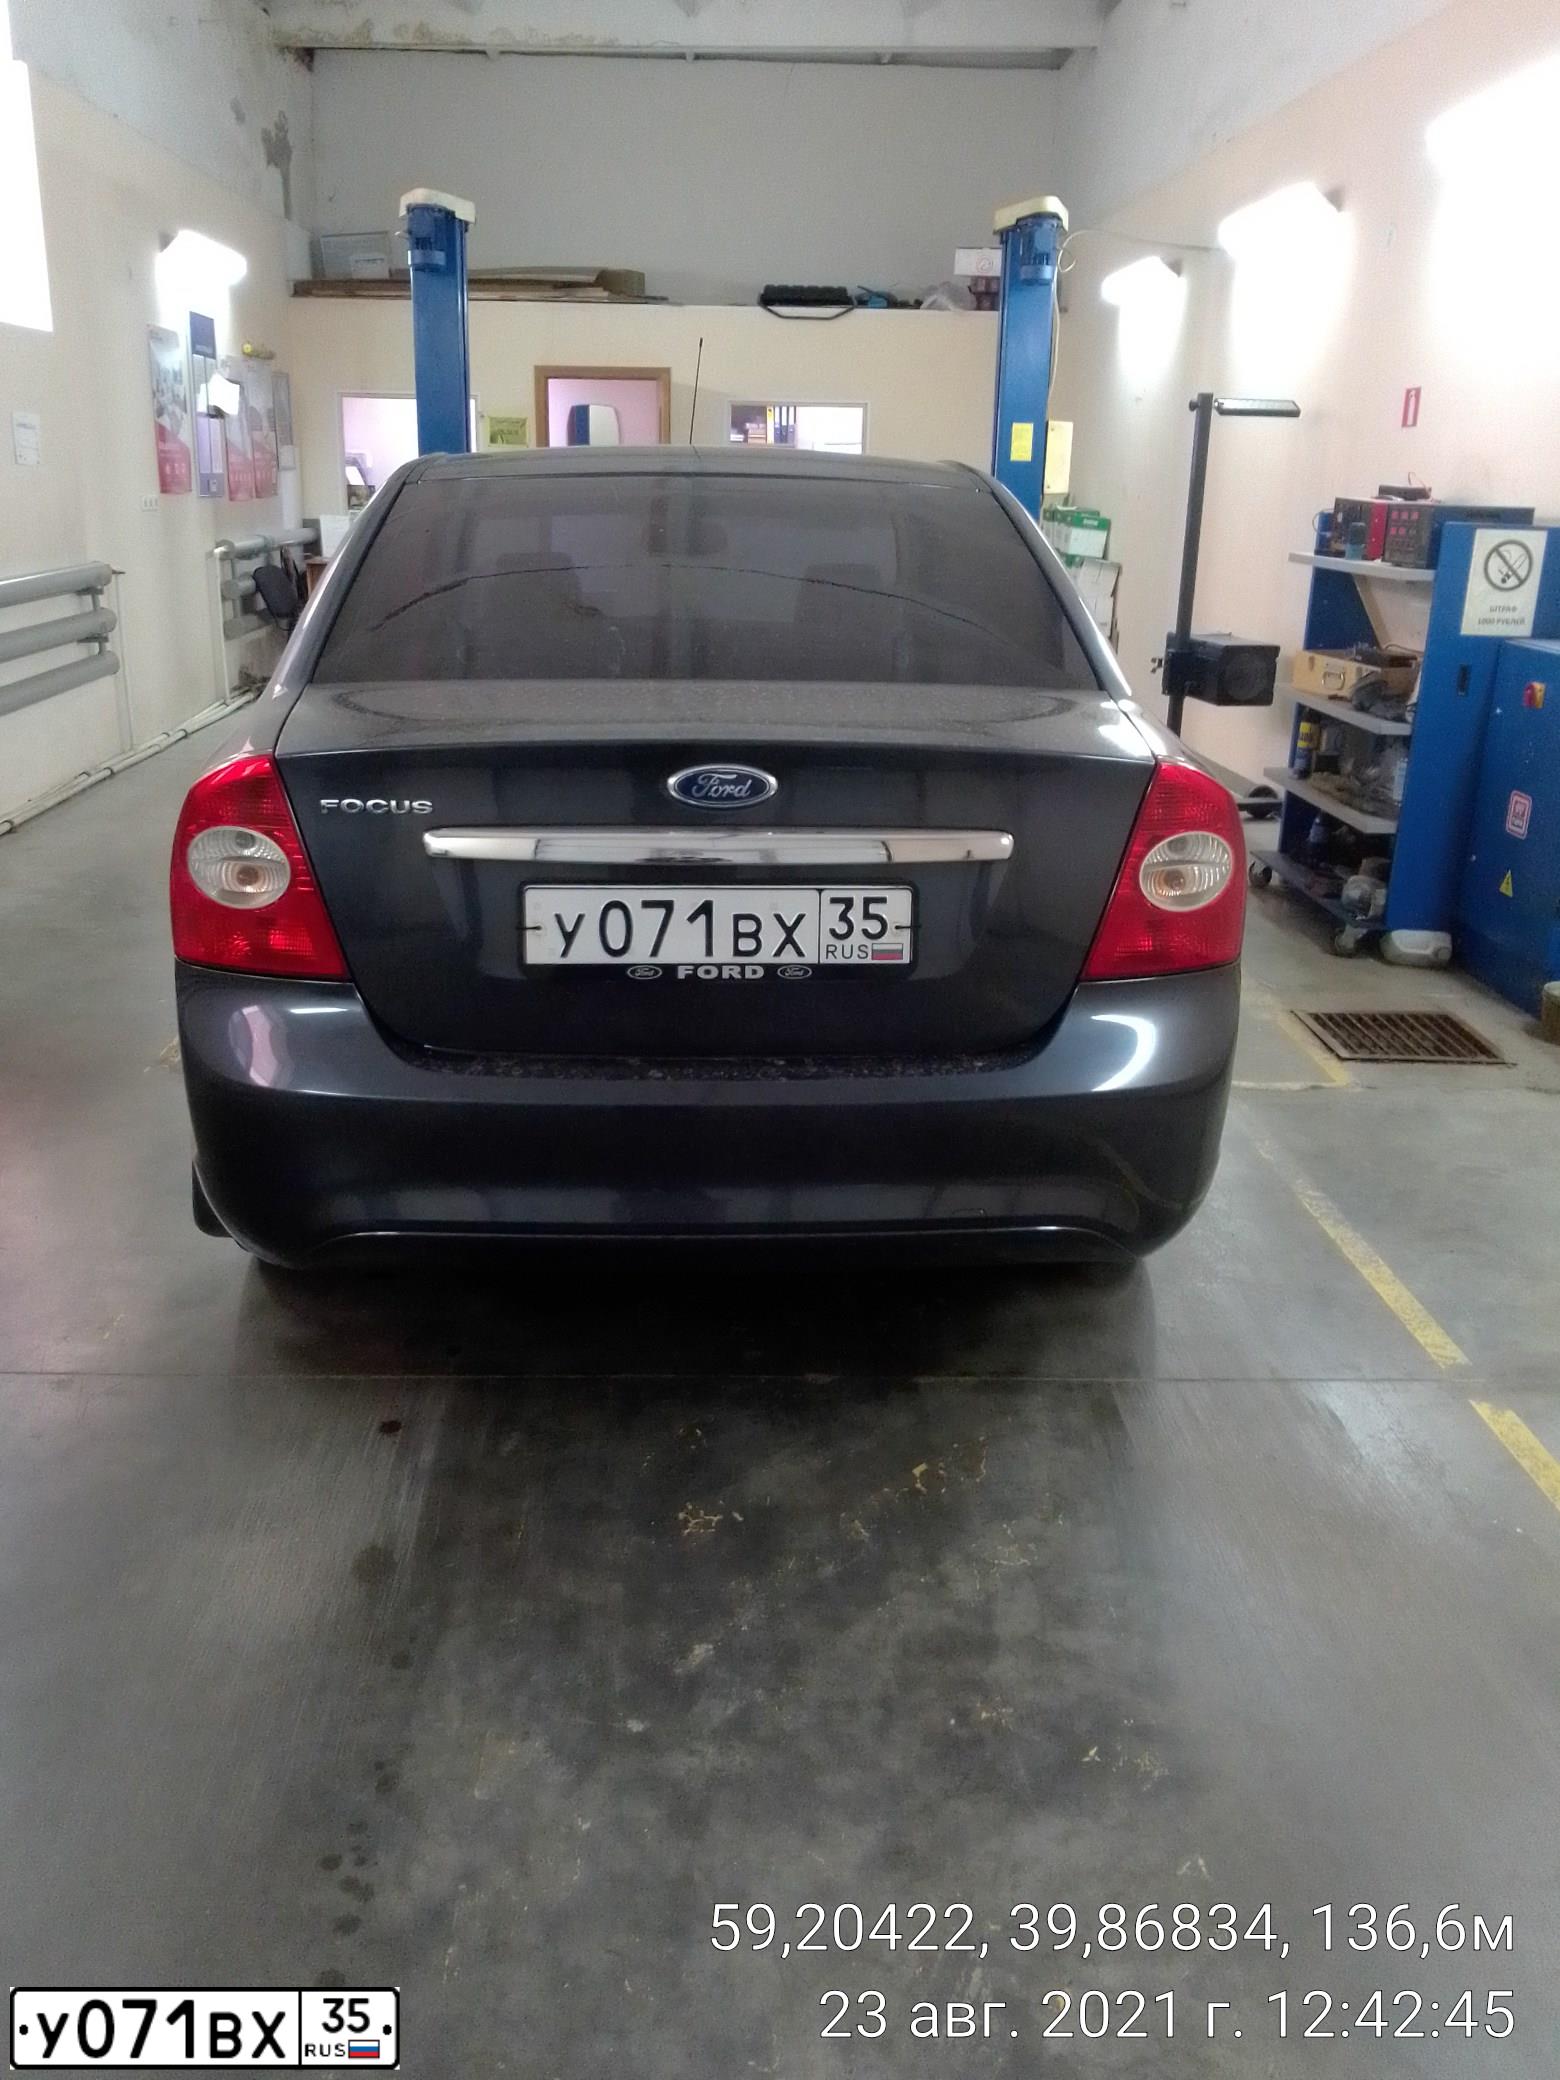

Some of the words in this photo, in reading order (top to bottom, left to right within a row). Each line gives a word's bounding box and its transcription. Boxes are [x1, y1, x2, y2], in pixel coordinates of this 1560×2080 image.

[692, 773, 752, 798] Ford
[319, 798, 434, 814] FOCUS
[828, 896, 889, 941] 35
[825, 943, 869, 960] RUS
[677, 965, 765, 980] FORD
